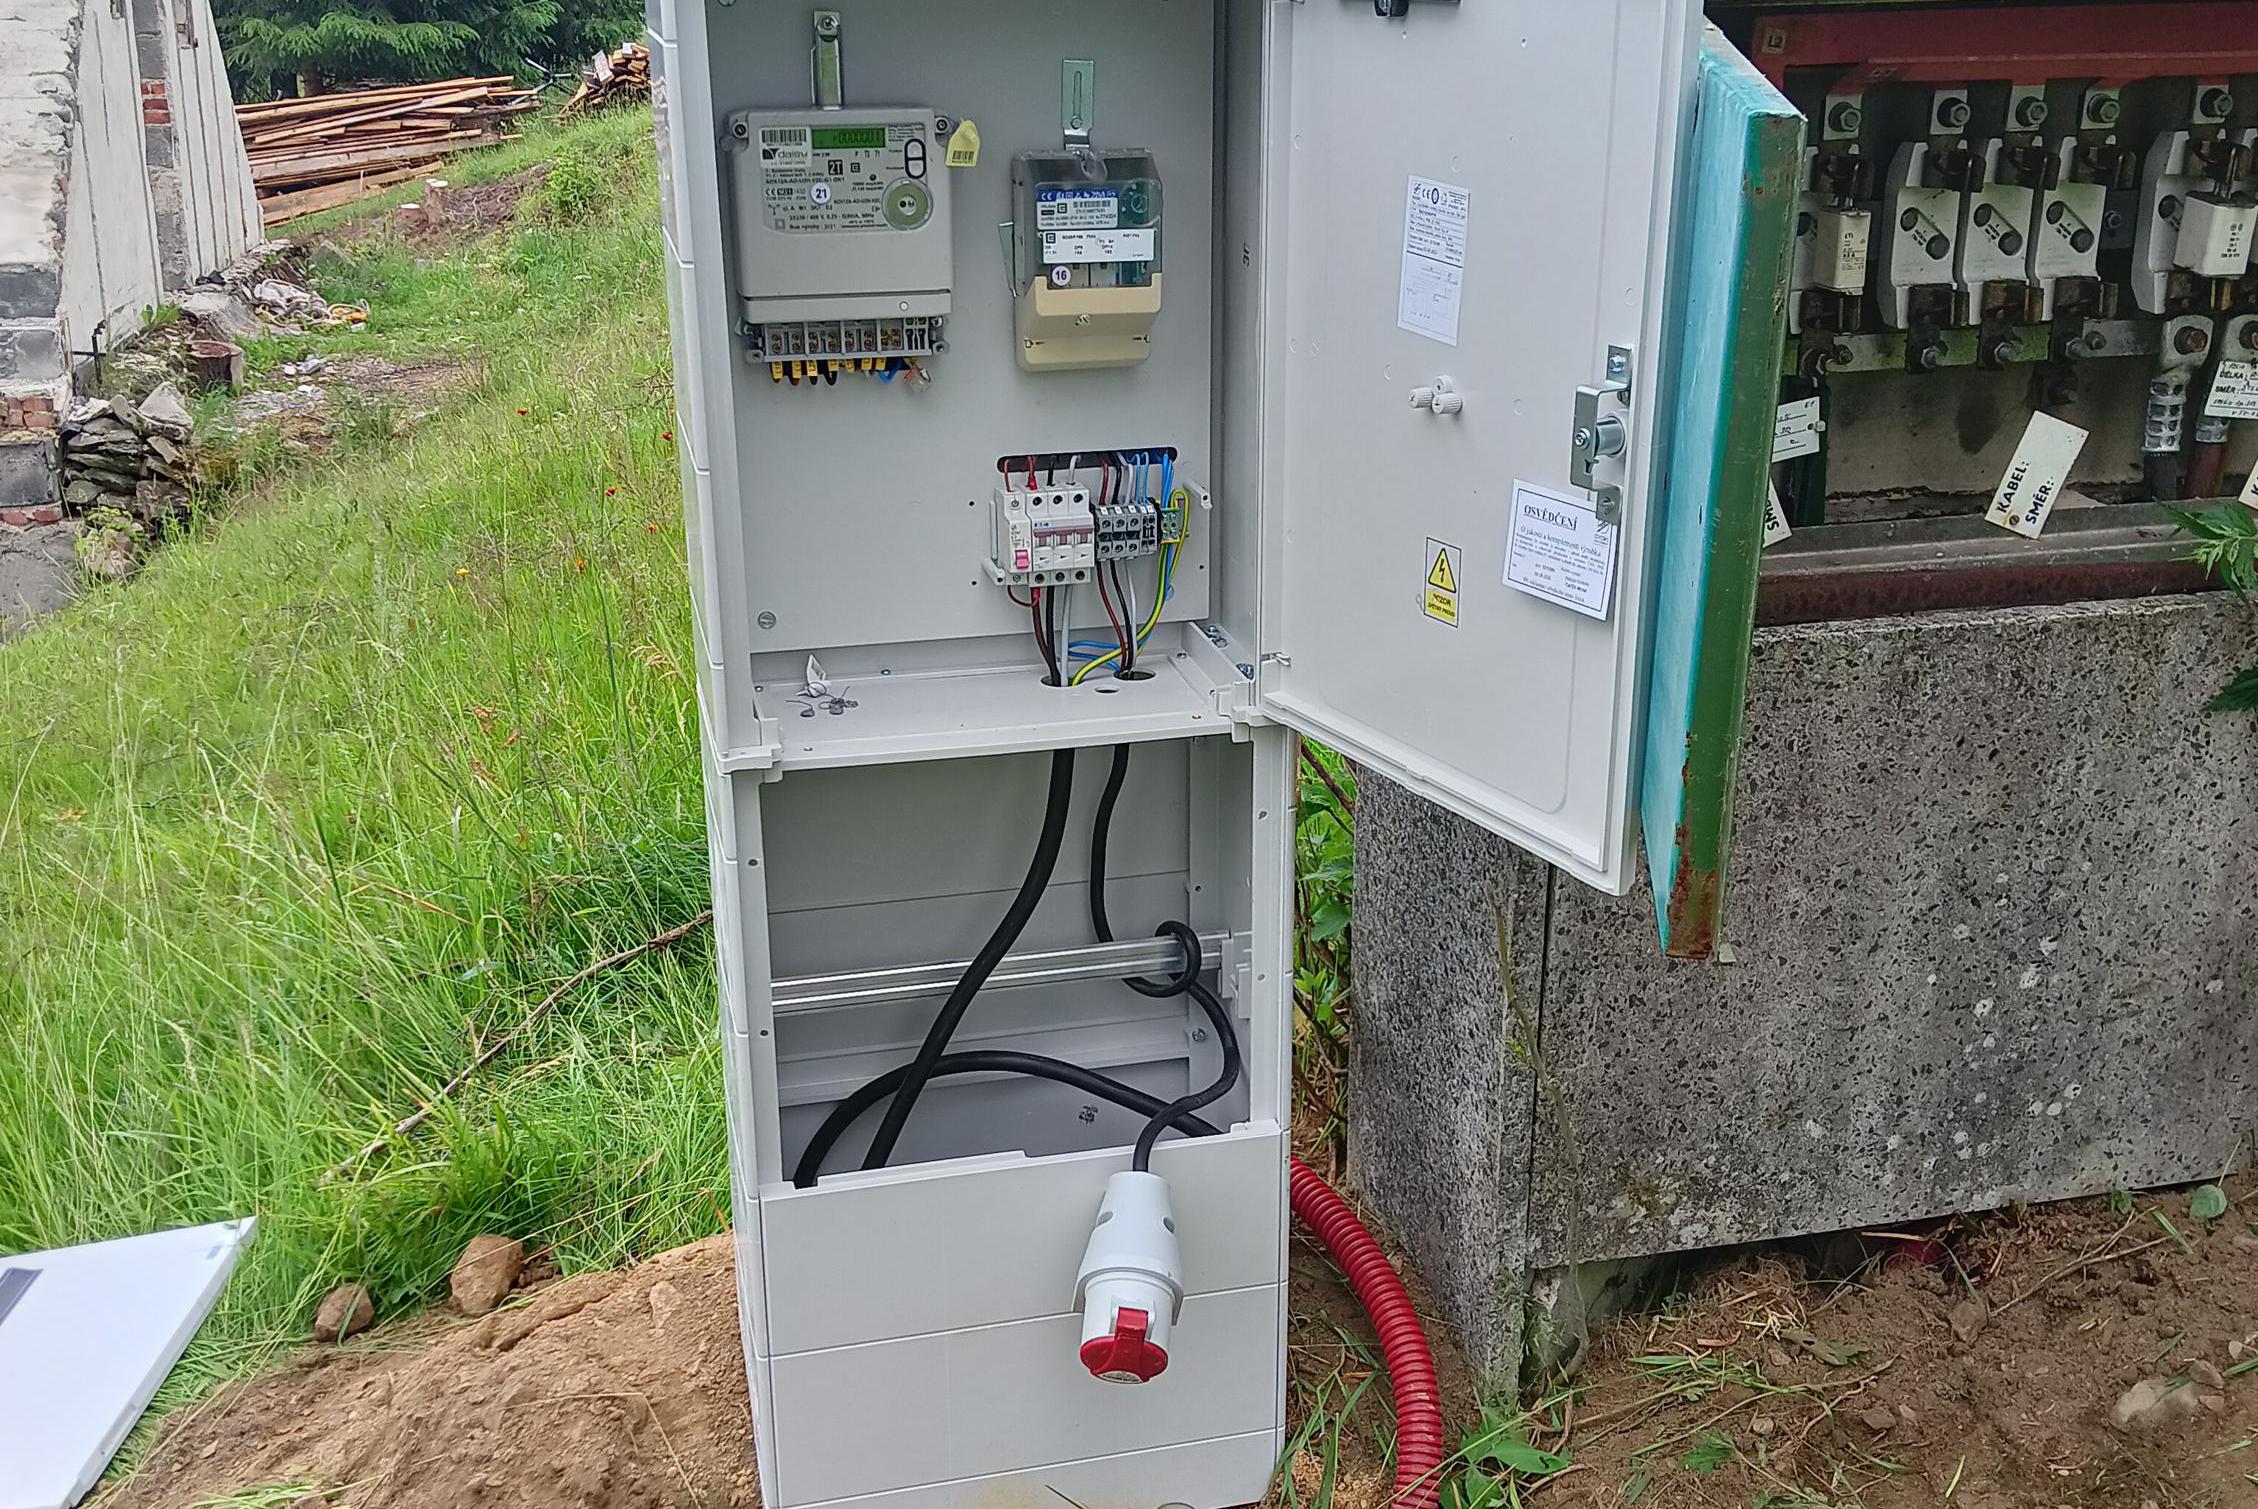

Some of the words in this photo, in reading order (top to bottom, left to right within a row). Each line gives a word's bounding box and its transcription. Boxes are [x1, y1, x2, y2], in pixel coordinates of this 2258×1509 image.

[815, 188, 828, 199] 21
[1055, 271, 1068, 281] 16
[1996, 461, 2029, 513] KABEL:
[1524, 504, 1578, 531] OSVĚDČENÍ
